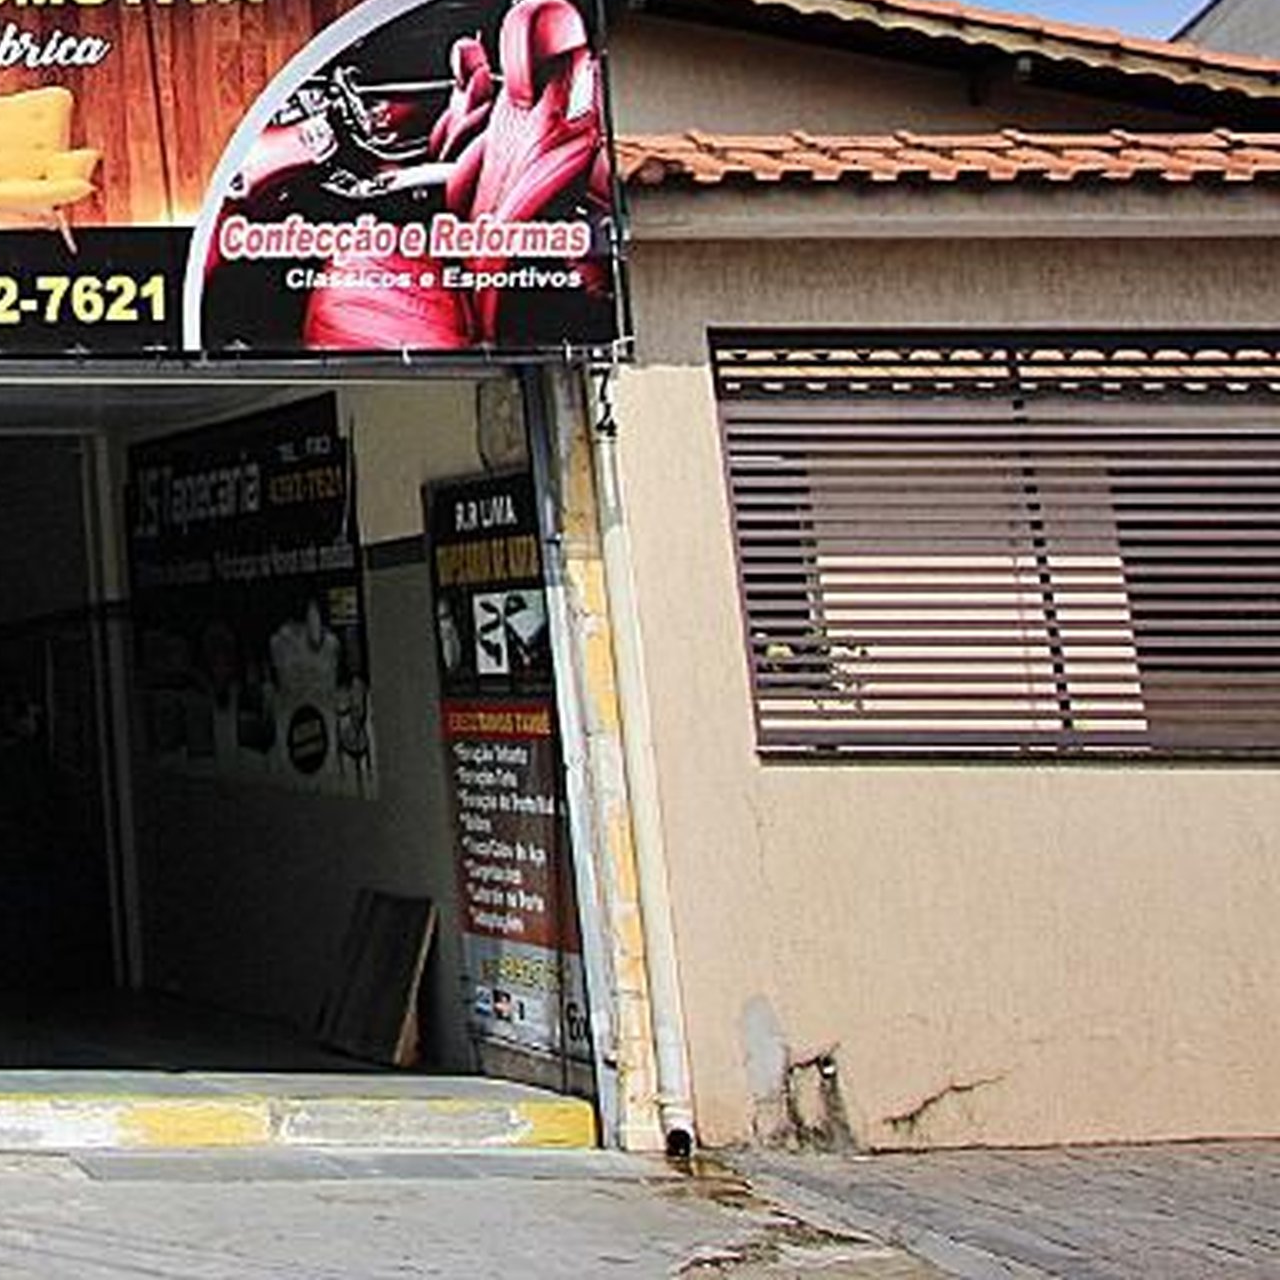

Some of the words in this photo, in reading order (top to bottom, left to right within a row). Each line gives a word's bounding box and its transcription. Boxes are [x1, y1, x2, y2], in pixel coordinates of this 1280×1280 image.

[220, 213, 397, 265] Confecção
[400, 222, 427, 258] e
[431, 213, 591, 258] Reformas
[418, 272, 436, 289] e
[442, 266, 582, 295] Esportivos
